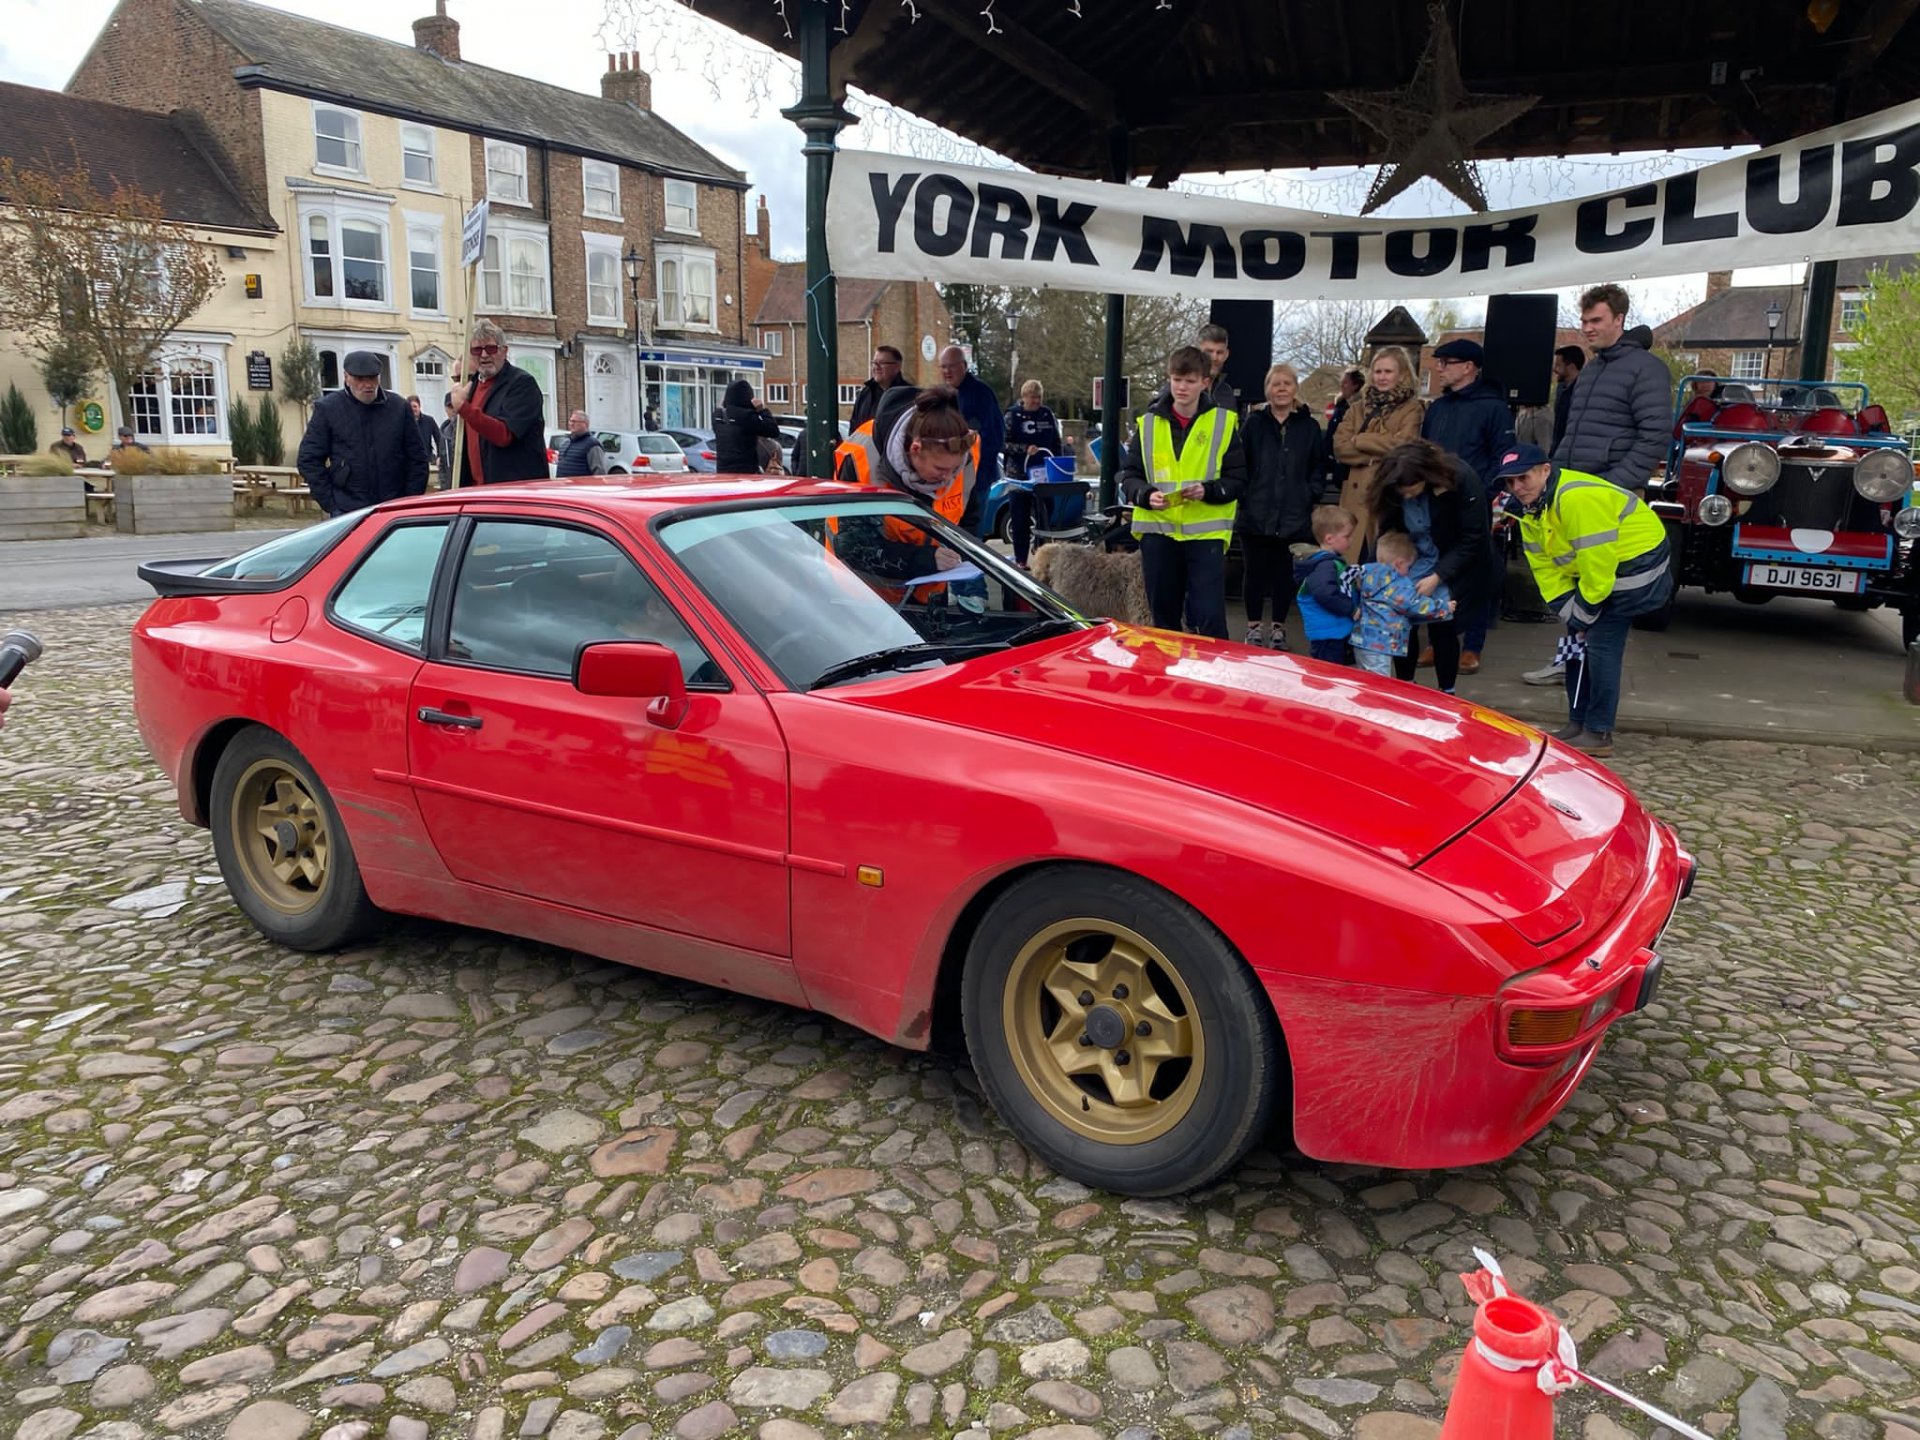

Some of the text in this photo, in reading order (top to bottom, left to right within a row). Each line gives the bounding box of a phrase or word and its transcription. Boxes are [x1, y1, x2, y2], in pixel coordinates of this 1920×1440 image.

[868, 123, 1920, 280] YORK MOTOR CLUB
[1767, 569, 1842, 589] DJI 9631
